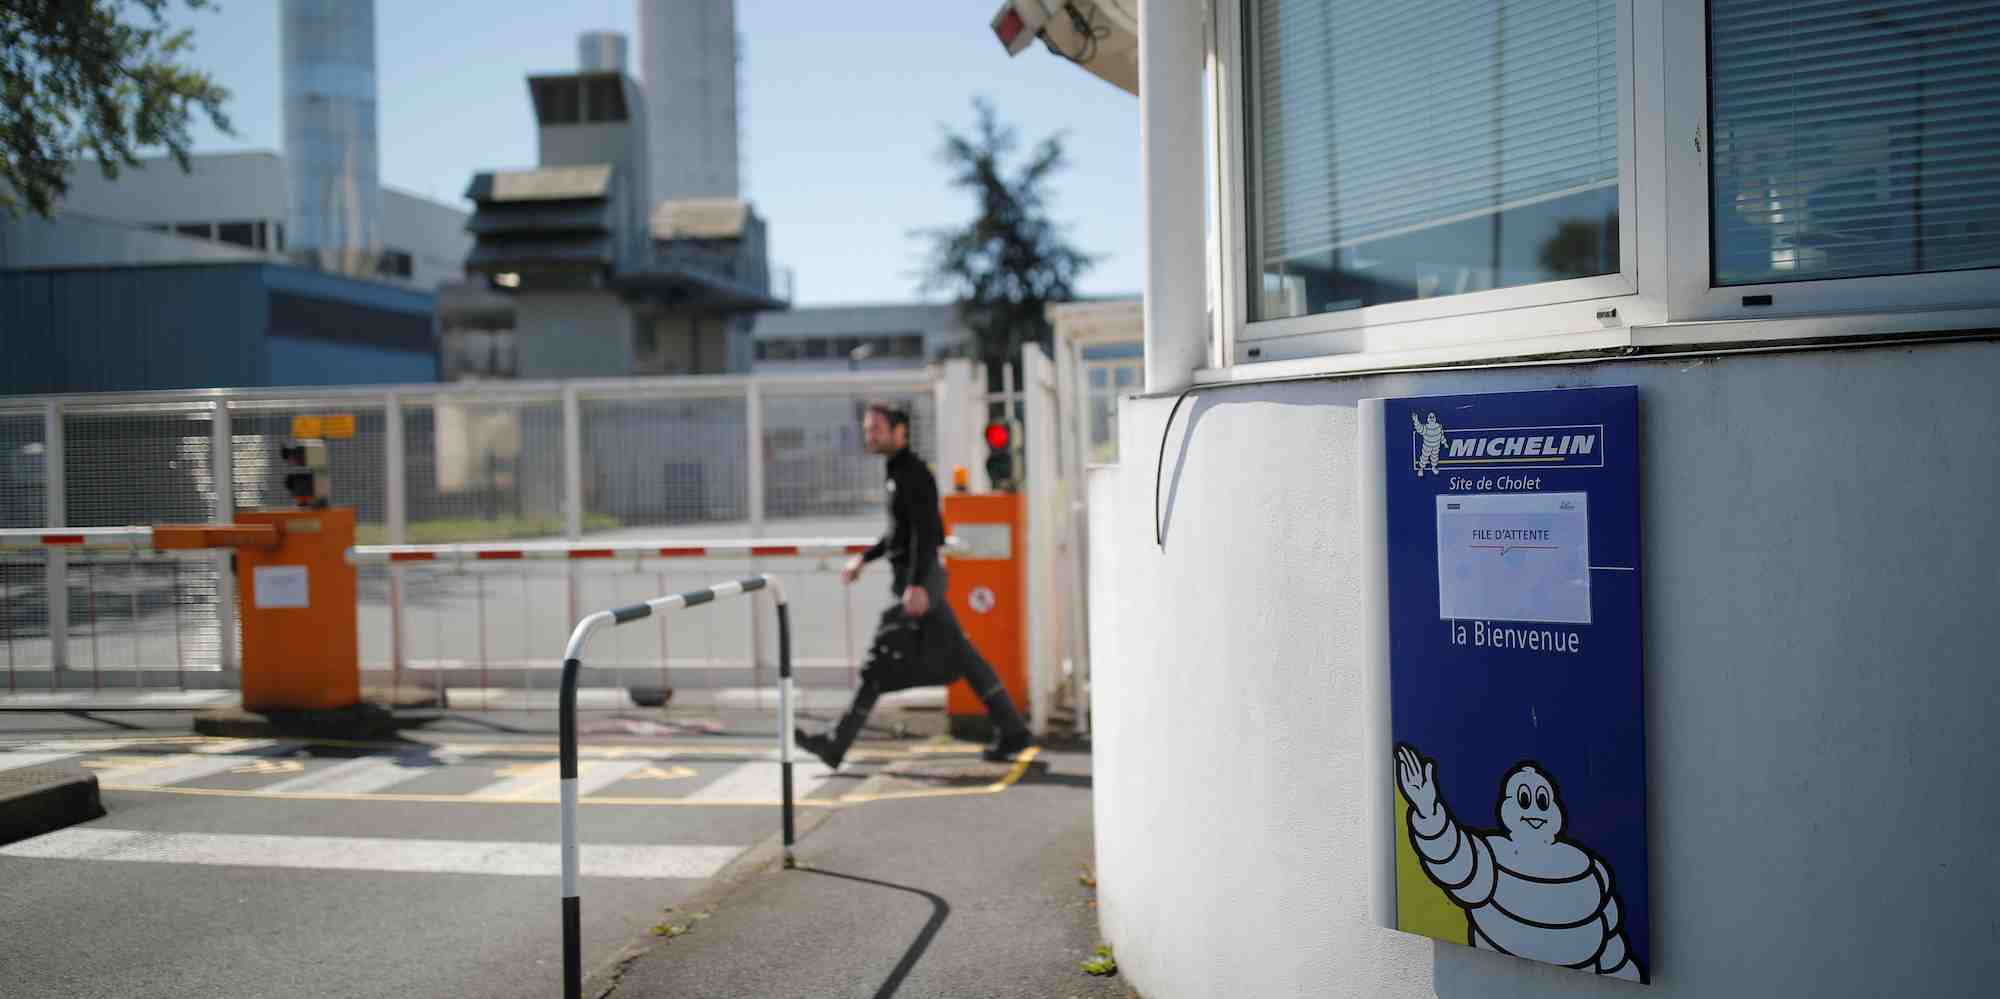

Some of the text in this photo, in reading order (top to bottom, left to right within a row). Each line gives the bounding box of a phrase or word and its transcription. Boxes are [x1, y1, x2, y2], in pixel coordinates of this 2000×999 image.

[1449, 434, 1596, 457] MICHELIN
[1450, 475, 1541, 490] Site de Cholet
[1472, 529, 1550, 541] FILE D'ATTENTE
[1452, 616, 1580, 652] la Bienvenue
